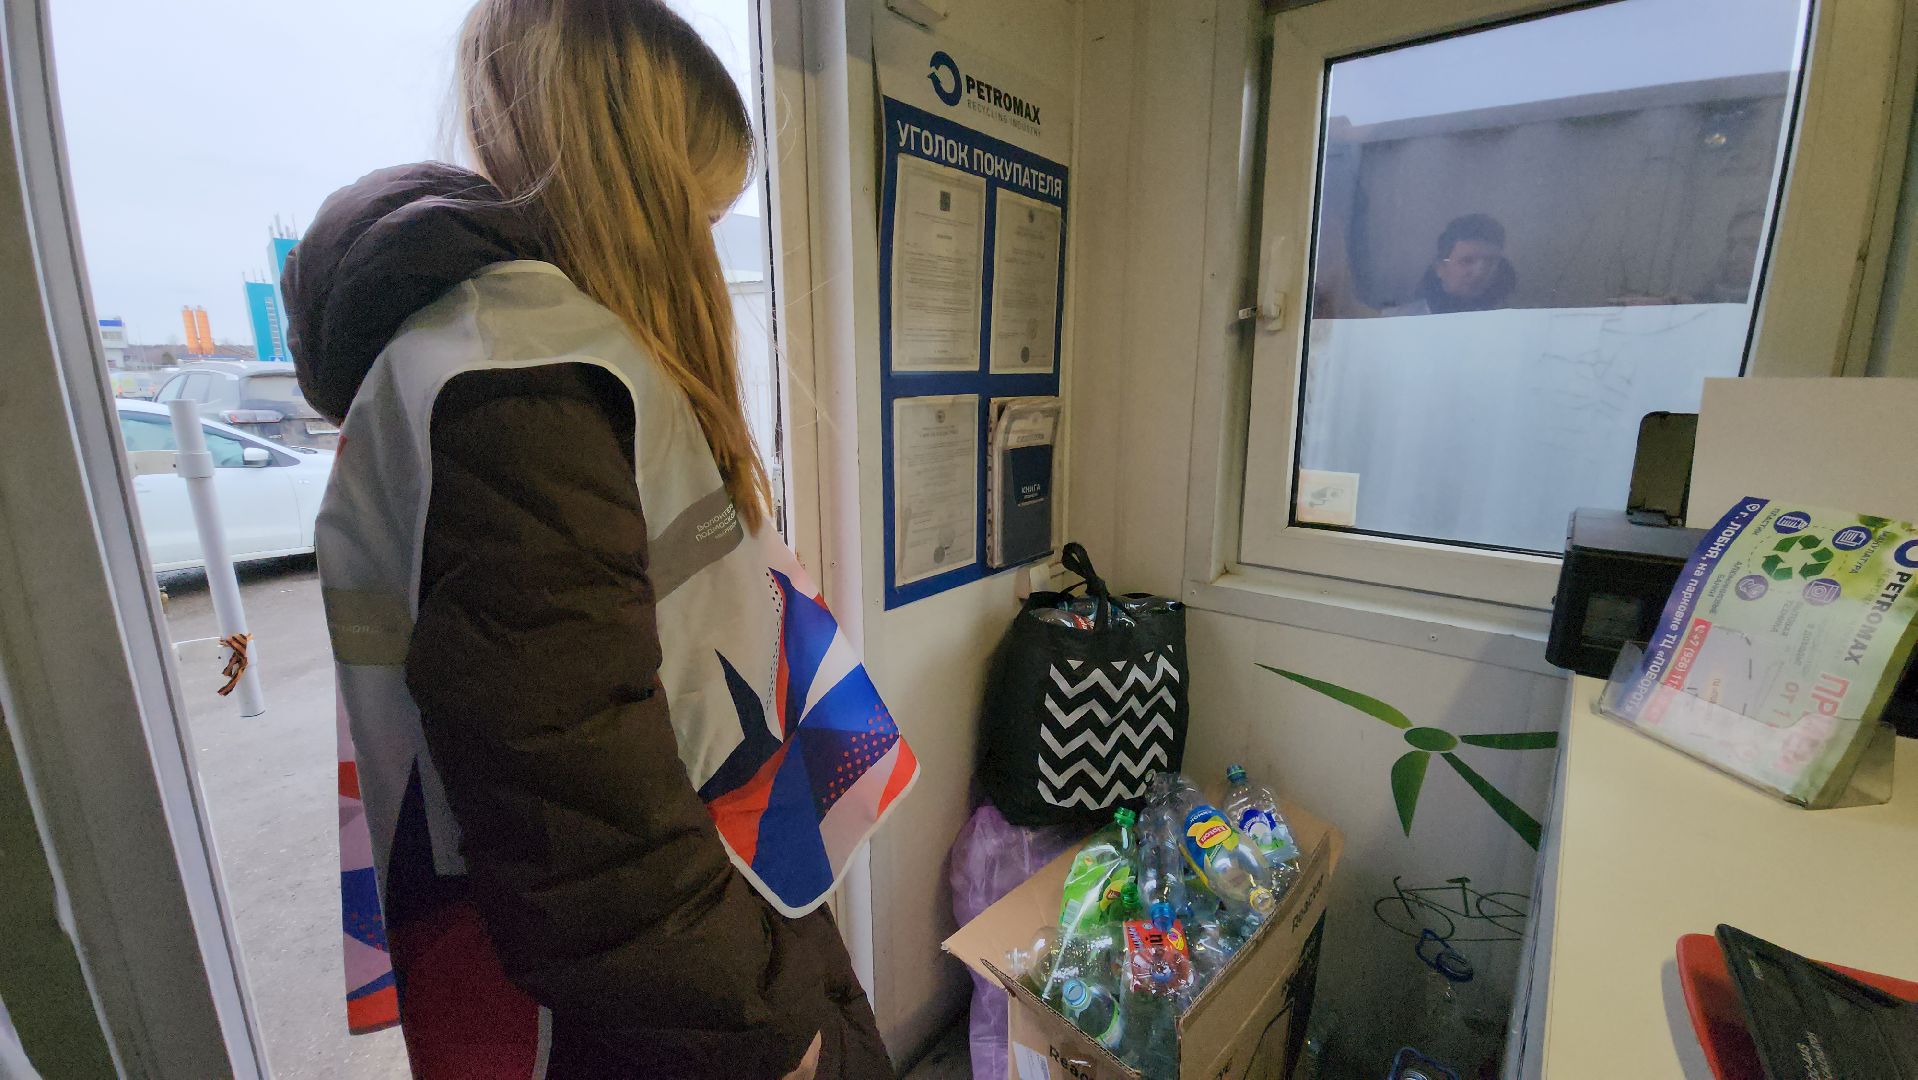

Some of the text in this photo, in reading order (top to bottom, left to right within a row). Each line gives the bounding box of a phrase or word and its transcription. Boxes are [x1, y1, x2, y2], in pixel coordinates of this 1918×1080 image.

[965, 74, 1041, 125] PETROMAX
[896, 119, 1062, 199] УГОЛОК ПОКУПАТЕЛЯ
[1021, 483, 1041, 493] КНИГА
[1701, 521, 1741, 562] ЛОБНЯ,
[1694, 562, 1708, 577] на
[1670, 578, 1699, 631] парковке
[1844, 571, 1913, 666] PETROMAX
[1659, 633, 1678, 649] ТЦ
